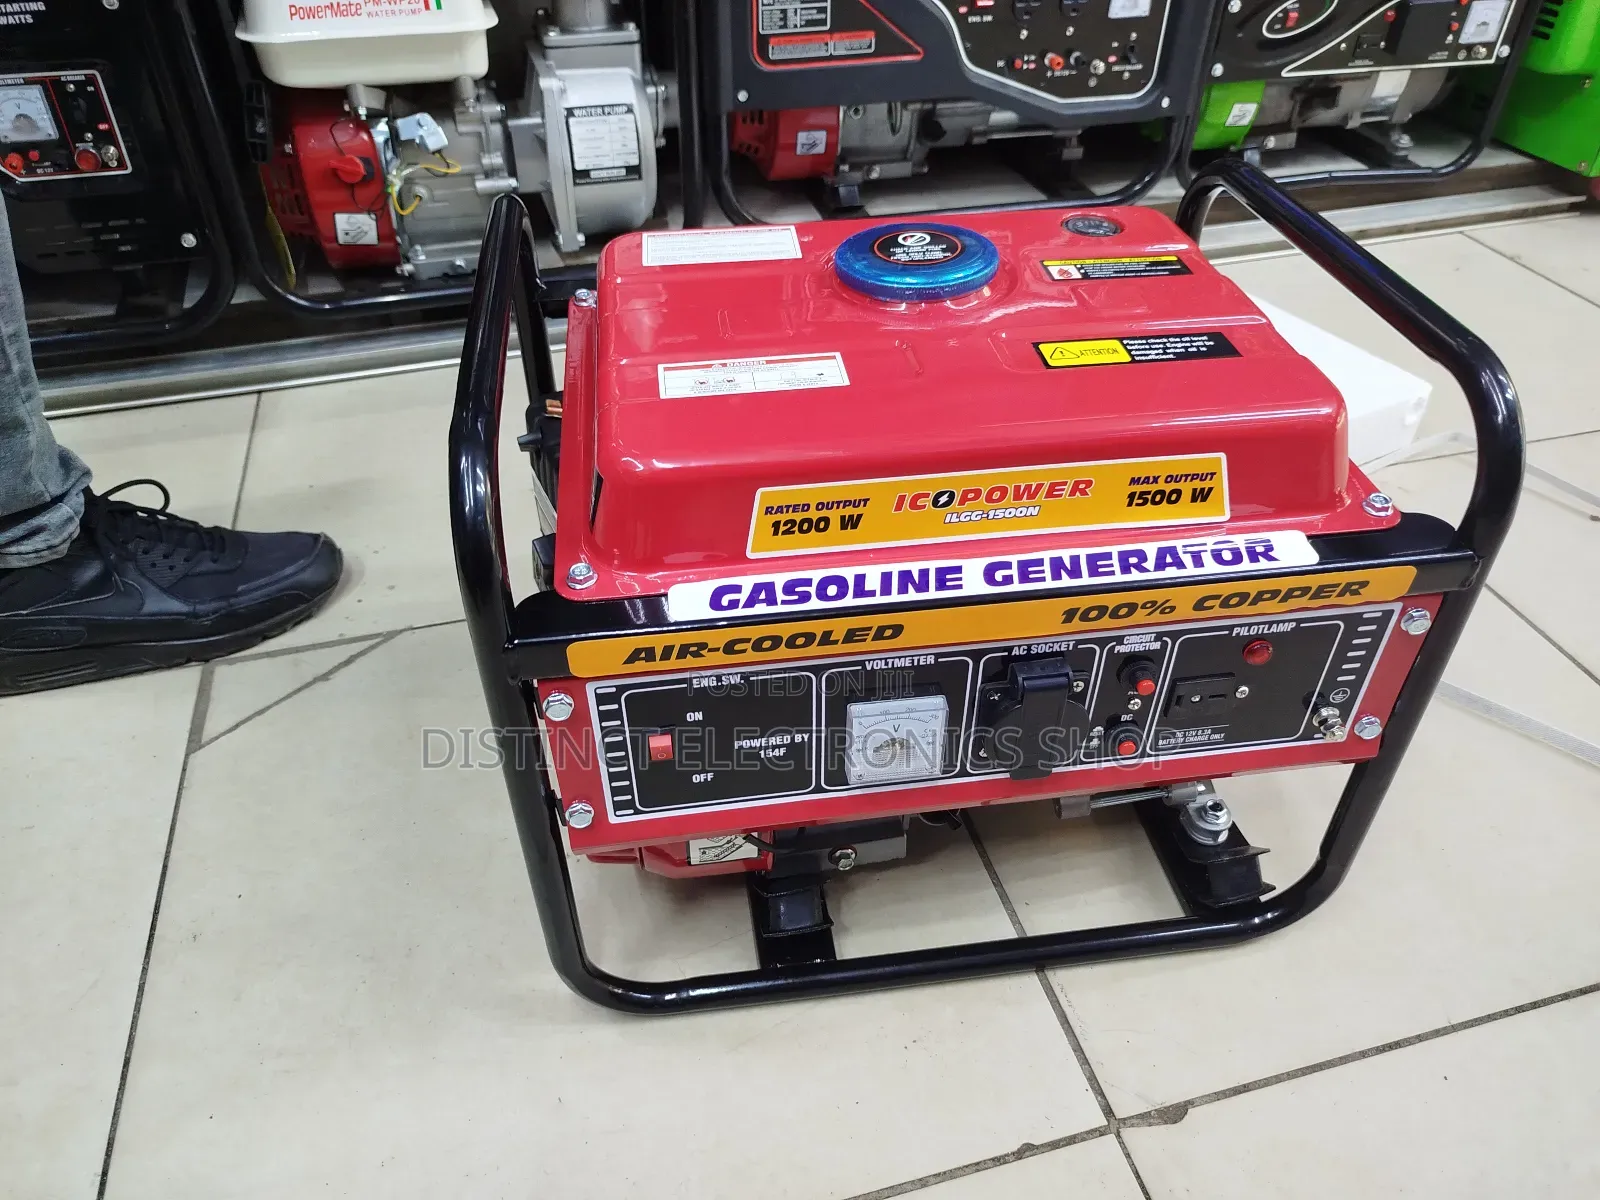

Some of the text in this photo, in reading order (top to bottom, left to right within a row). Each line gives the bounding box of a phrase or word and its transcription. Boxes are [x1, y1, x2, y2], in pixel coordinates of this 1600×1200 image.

[0, 1, 46, 13] TARTING
[288, 1, 362, 20] PowerMate
[366, 8, 423, 18] WATER PUMP
[572, 105, 628, 117] WATER PUMP
[1079, 347, 1119, 357] ATTENTION
[1128, 472, 1217, 486] MAX OUTPUT
[1126, 486, 1214, 507] 1500 W
[764, 498, 870, 516] RATED OUTPUT
[943, 506, 1042, 524] ILGG-1500N
[771, 513, 864, 536] 1200 W
[708, 537, 1281, 612] GASOLINE GENERATOR
[1059, 580, 1371, 625] 100% COPPER
[1231, 622, 1296, 636] PILOTLAMP
[621, 623, 905, 665] AIR-COOLED
[1123, 633, 1157, 644] CIRCUIT
[1011, 641, 1075, 656] AC SOCKET
[1114, 641, 1161, 653] PROTECTOR
[864, 655, 935, 671] VOLTMETER
[686, 711, 703, 722] ON
[1120, 714, 1134, 722] DC
[892, 724, 900, 733] V
[734, 733, 810, 750] POWERED BY
[1158, 738, 1185, 746] BATTERY
[1185, 735, 1209, 743] CHARGE
[758, 748, 787, 759] 154F
[692, 773, 714, 783] OFF
